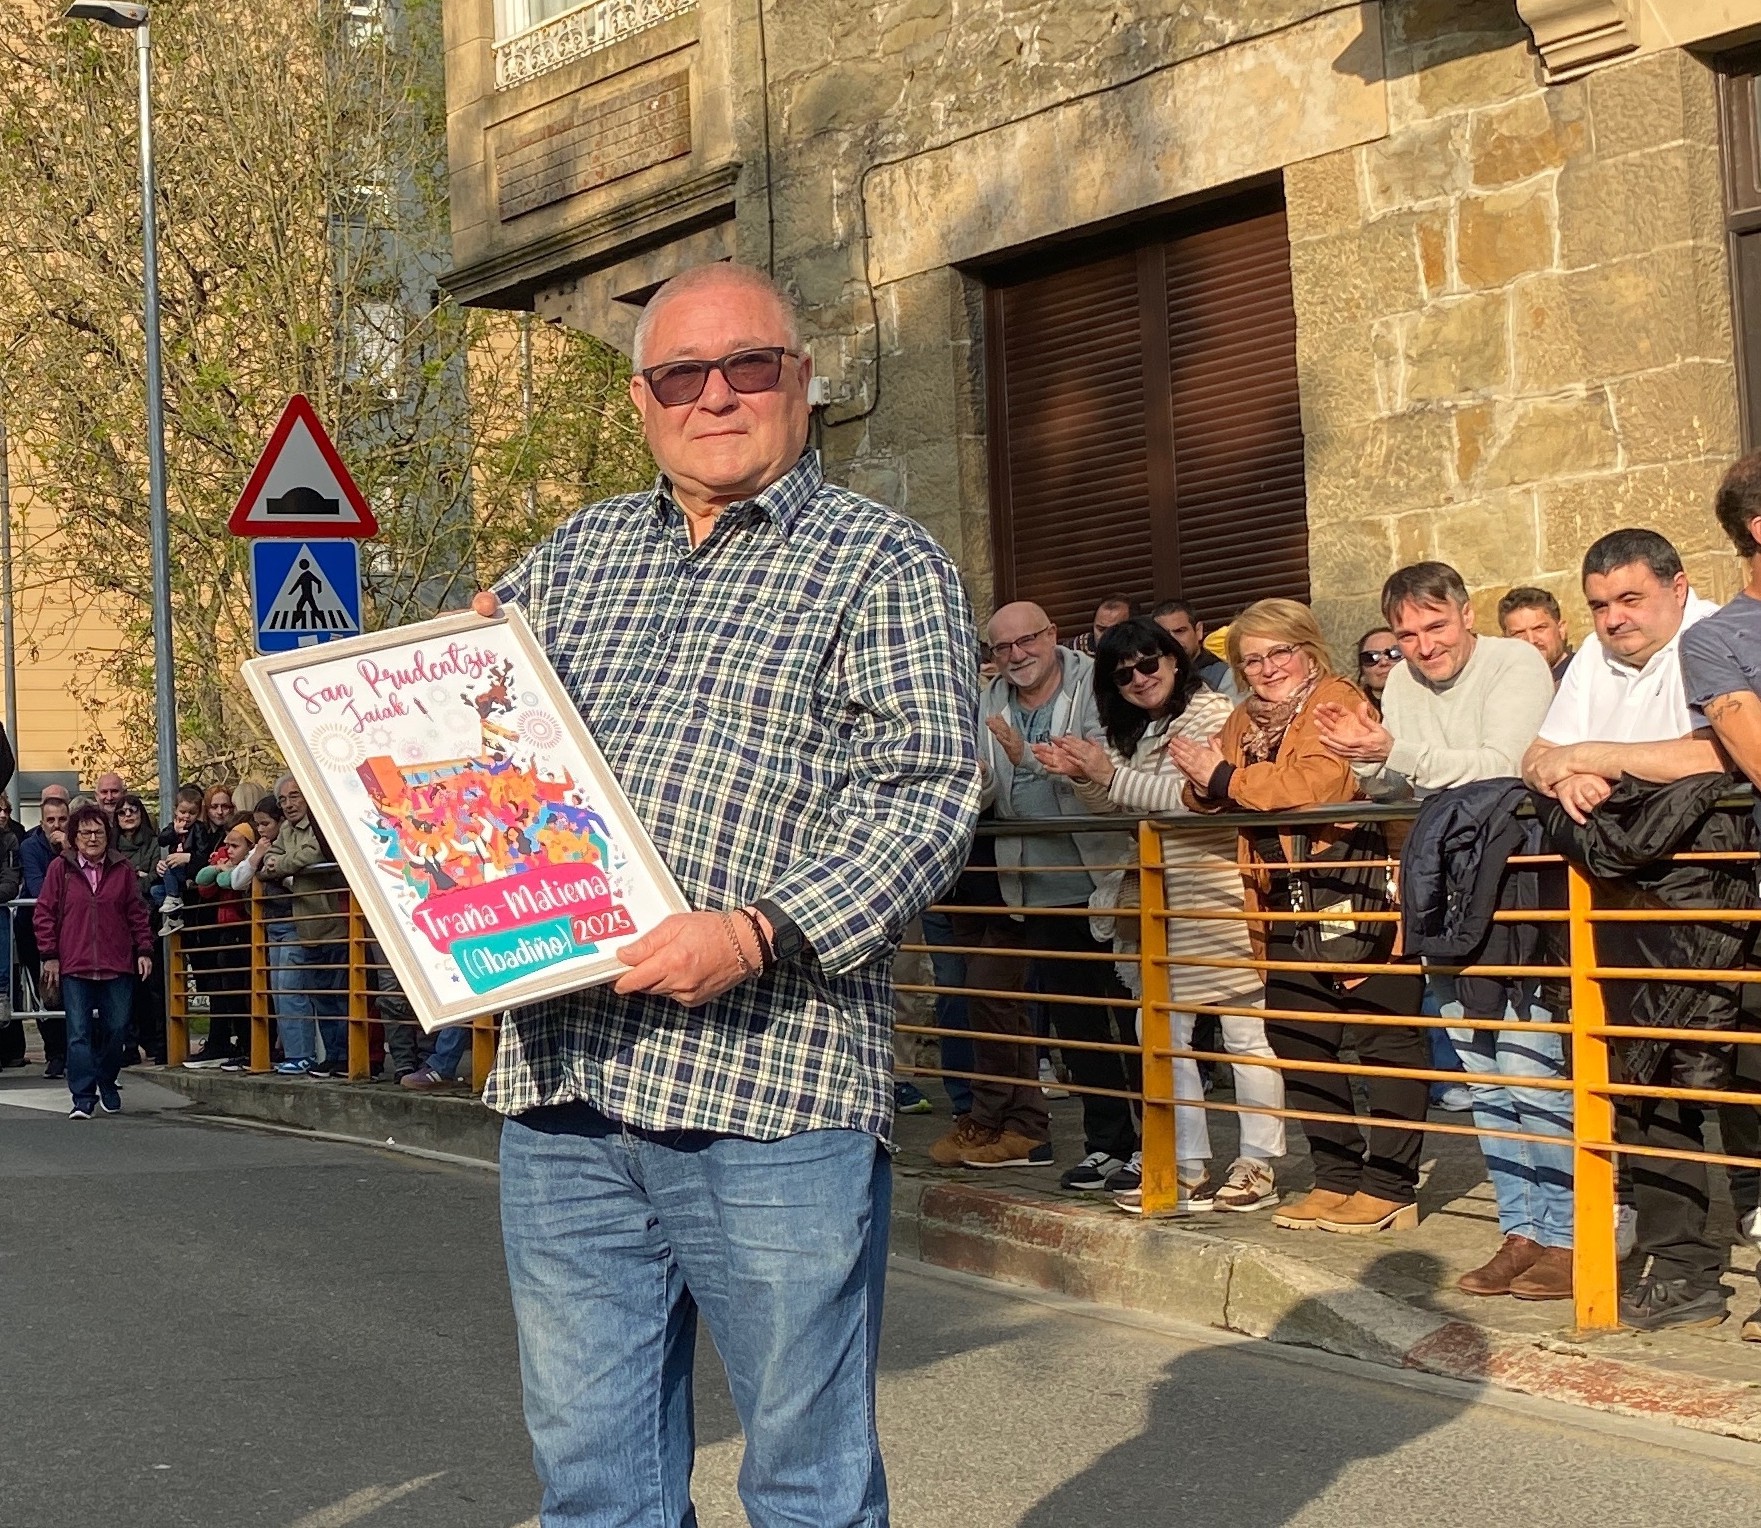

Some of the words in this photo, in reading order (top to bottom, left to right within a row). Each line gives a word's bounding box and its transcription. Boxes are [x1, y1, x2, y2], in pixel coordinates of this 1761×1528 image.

[293, 675, 353, 714] San
[357, 642, 498, 698] Prudentzio
[341, 692, 410, 733] Jaiak
[416, 876, 609, 940] Traña-Matiena
[463, 923, 573, 979] (Abadiño)
[573, 912, 631, 940] 2025
